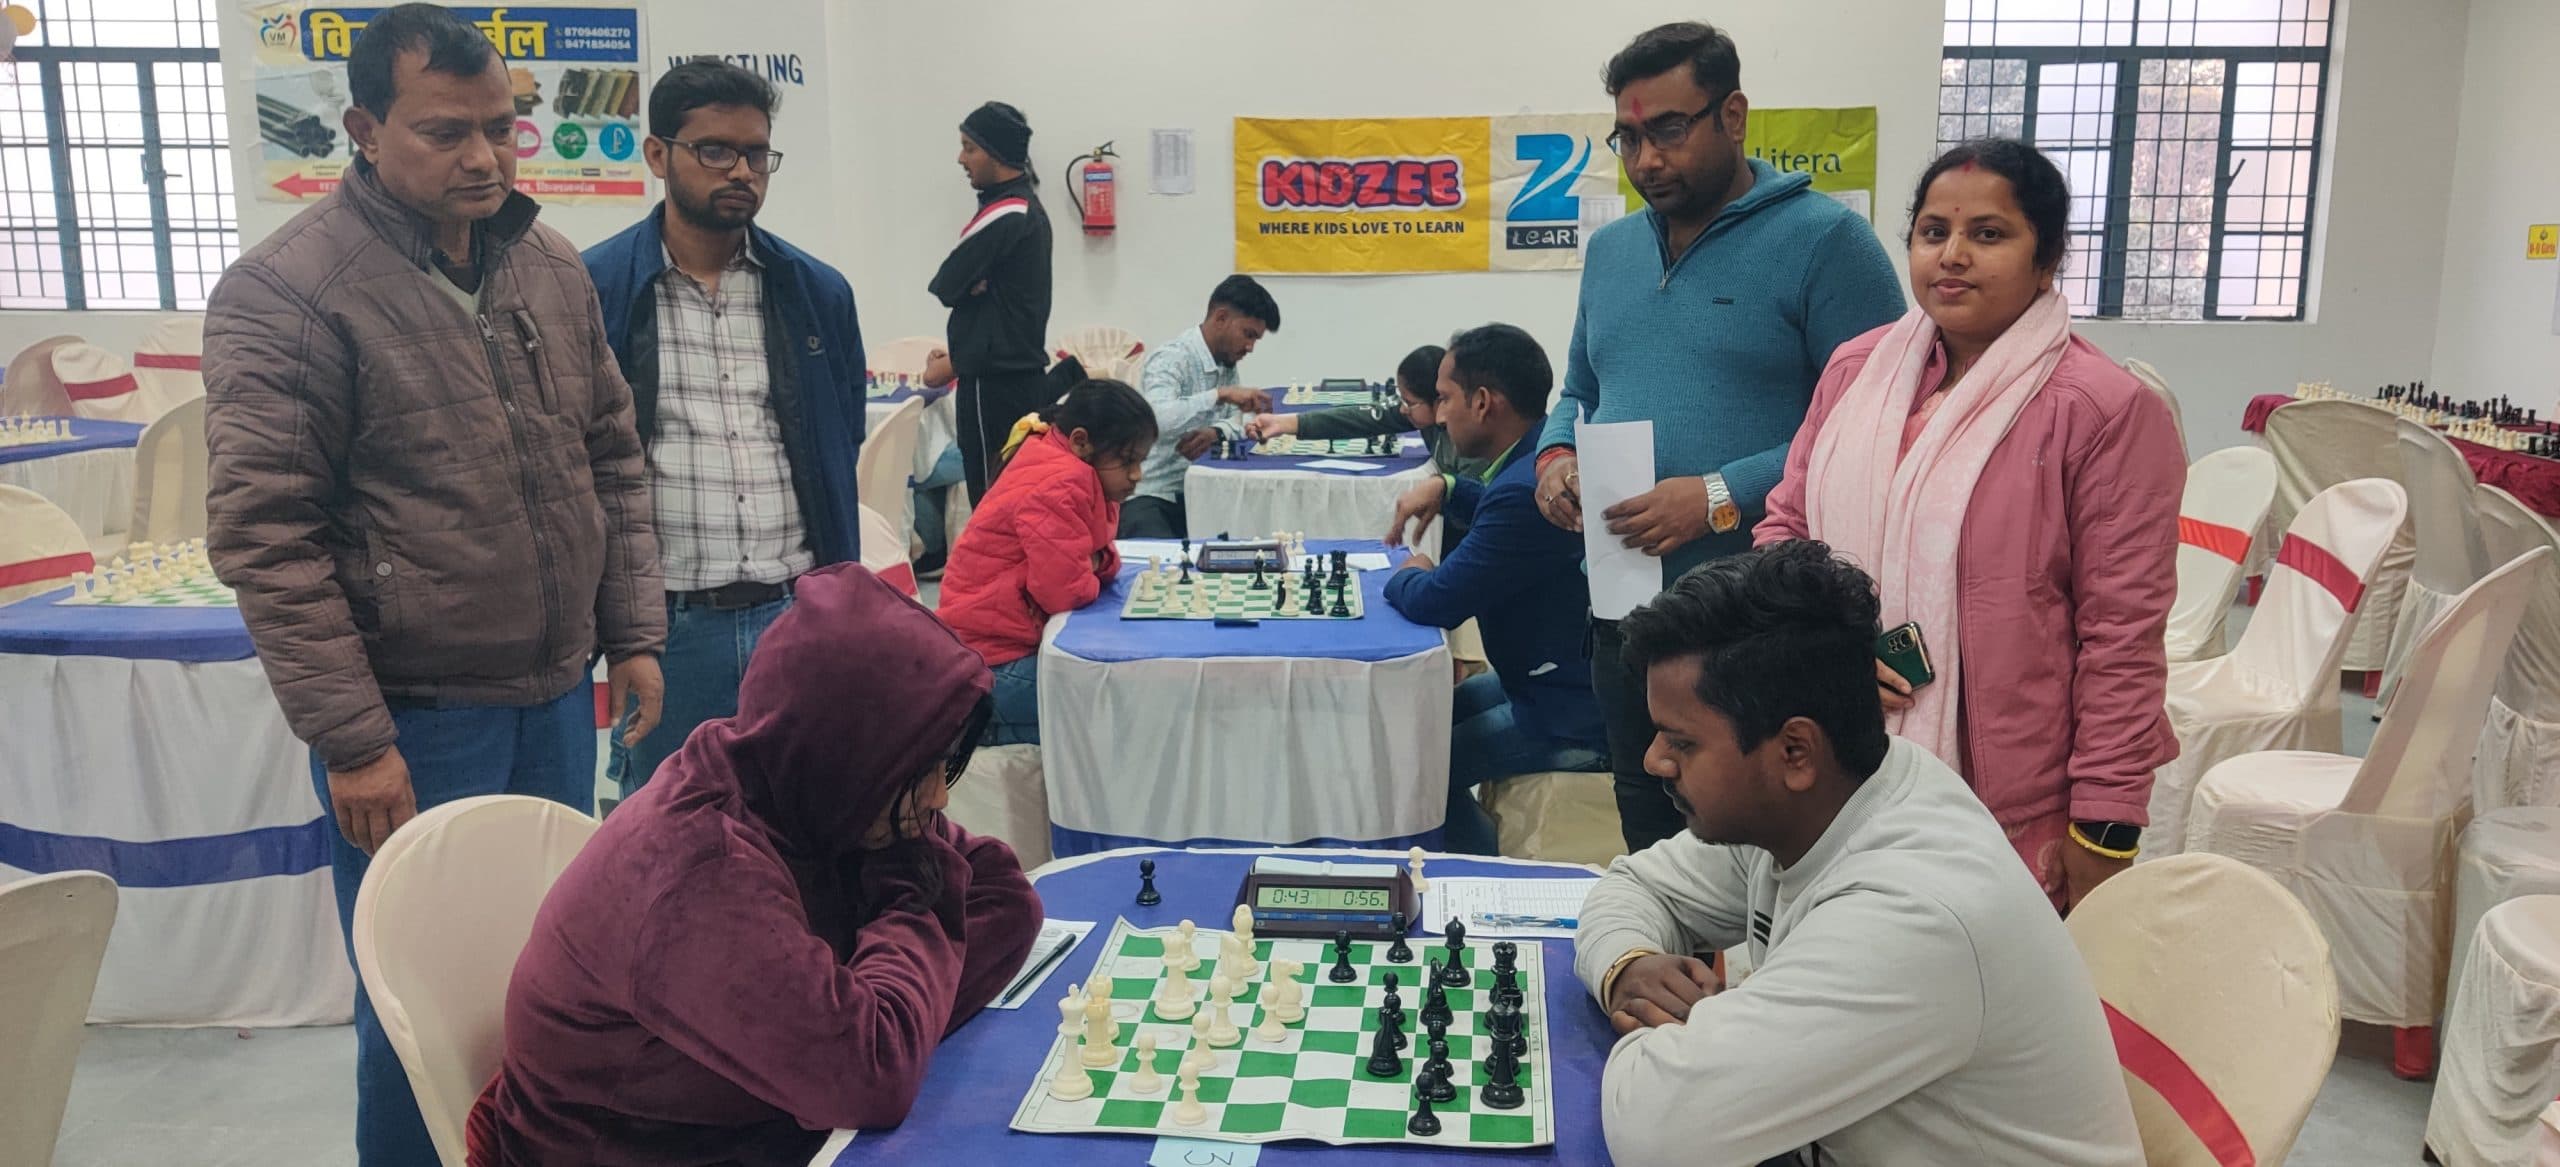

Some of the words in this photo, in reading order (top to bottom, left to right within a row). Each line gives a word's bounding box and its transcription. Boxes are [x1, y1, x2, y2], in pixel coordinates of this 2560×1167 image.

[1755, 147, 1843, 173] itera
[1262, 159, 1462, 208] KIDZEE
[1259, 222, 1309, 235] WHERE
[1314, 222, 1348, 235] KIDS
[1352, 222, 1388, 234] LOVE
[1392, 222, 1412, 234] TO
[1417, 221, 1465, 234] LEARN
[1272, 889, 1310, 904] 0:43
[1183, 1149, 1234, 1166] 3
